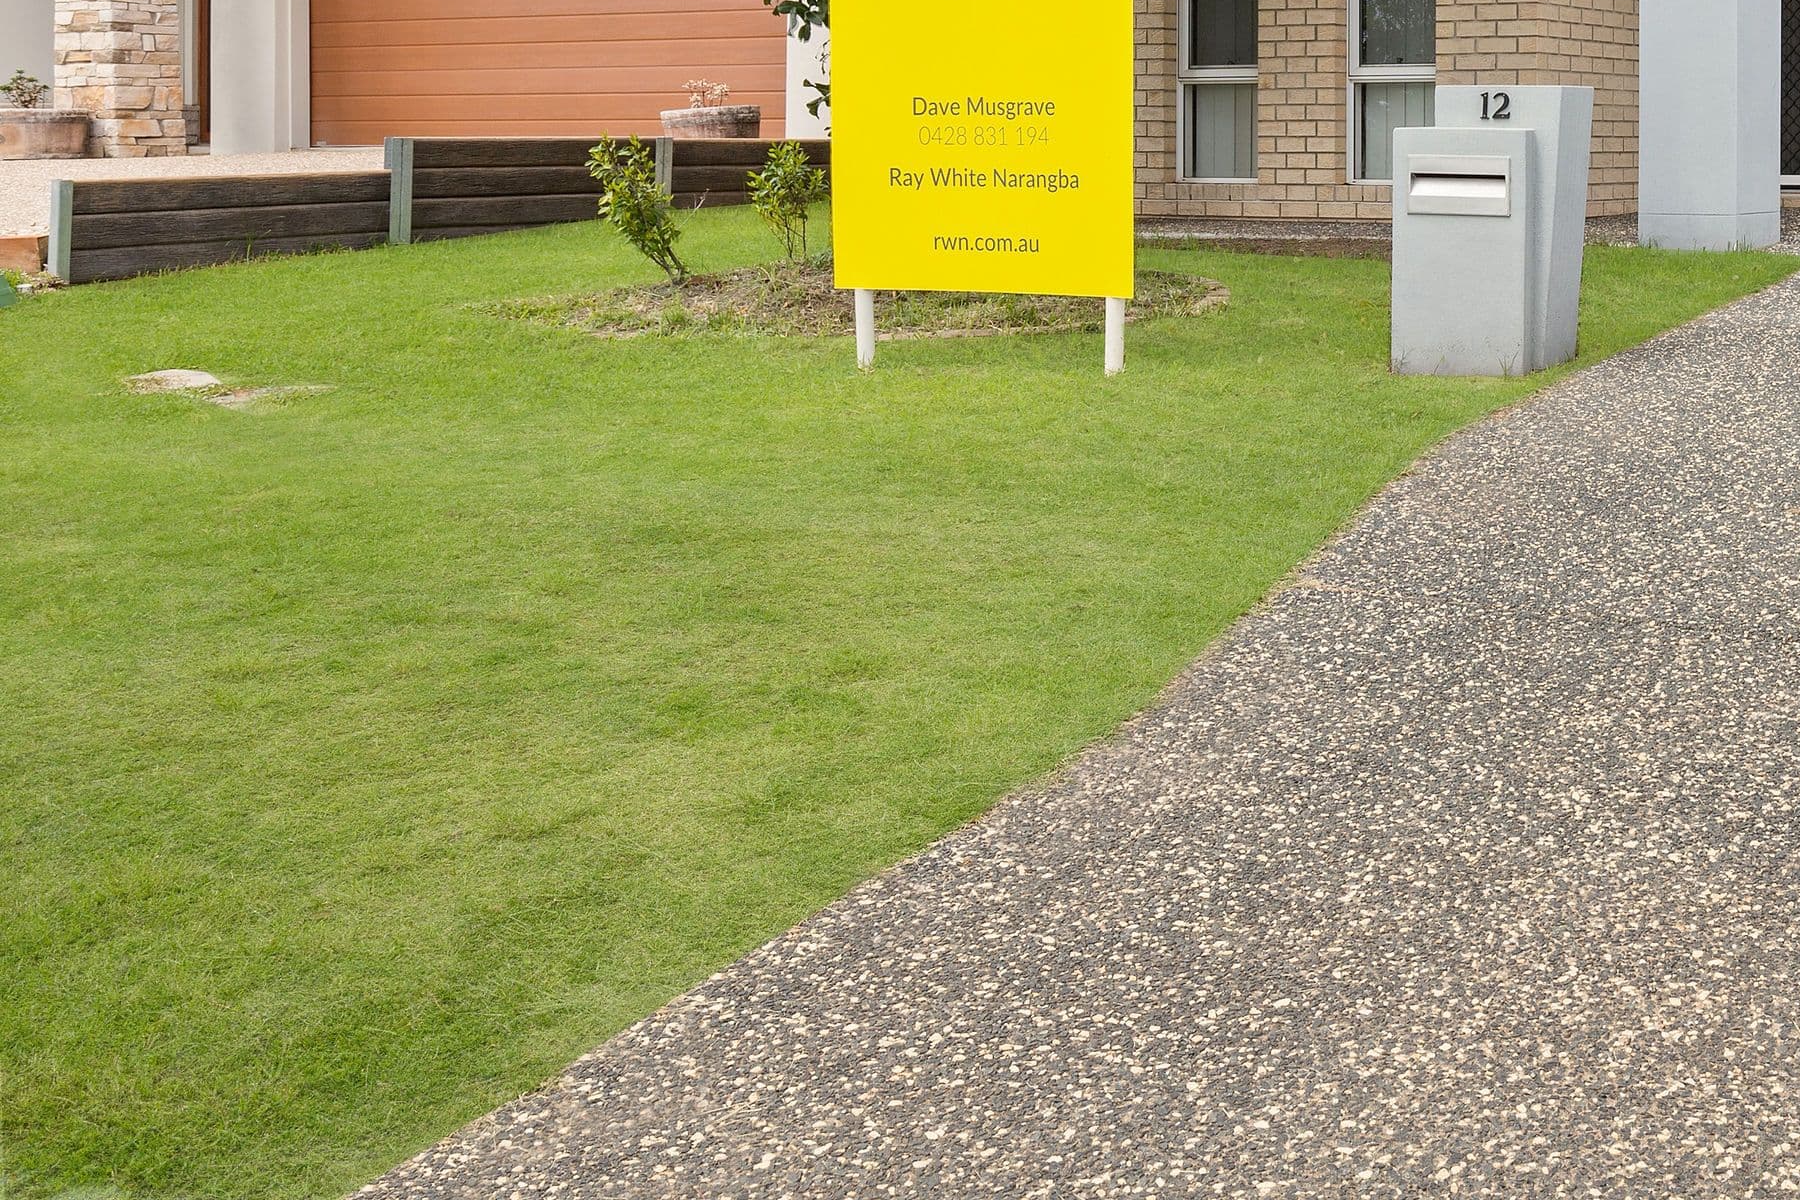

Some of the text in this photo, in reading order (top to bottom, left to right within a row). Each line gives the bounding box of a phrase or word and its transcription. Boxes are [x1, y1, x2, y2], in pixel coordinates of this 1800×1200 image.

[912, 97, 1056, 120] Dave Musgrave
[1479, 92, 1511, 120] 12
[918, 126, 1050, 146] 0428 831 194
[889, 167, 1080, 193] Ray White Narangba
[933, 235, 1040, 253] rwn.com.au
